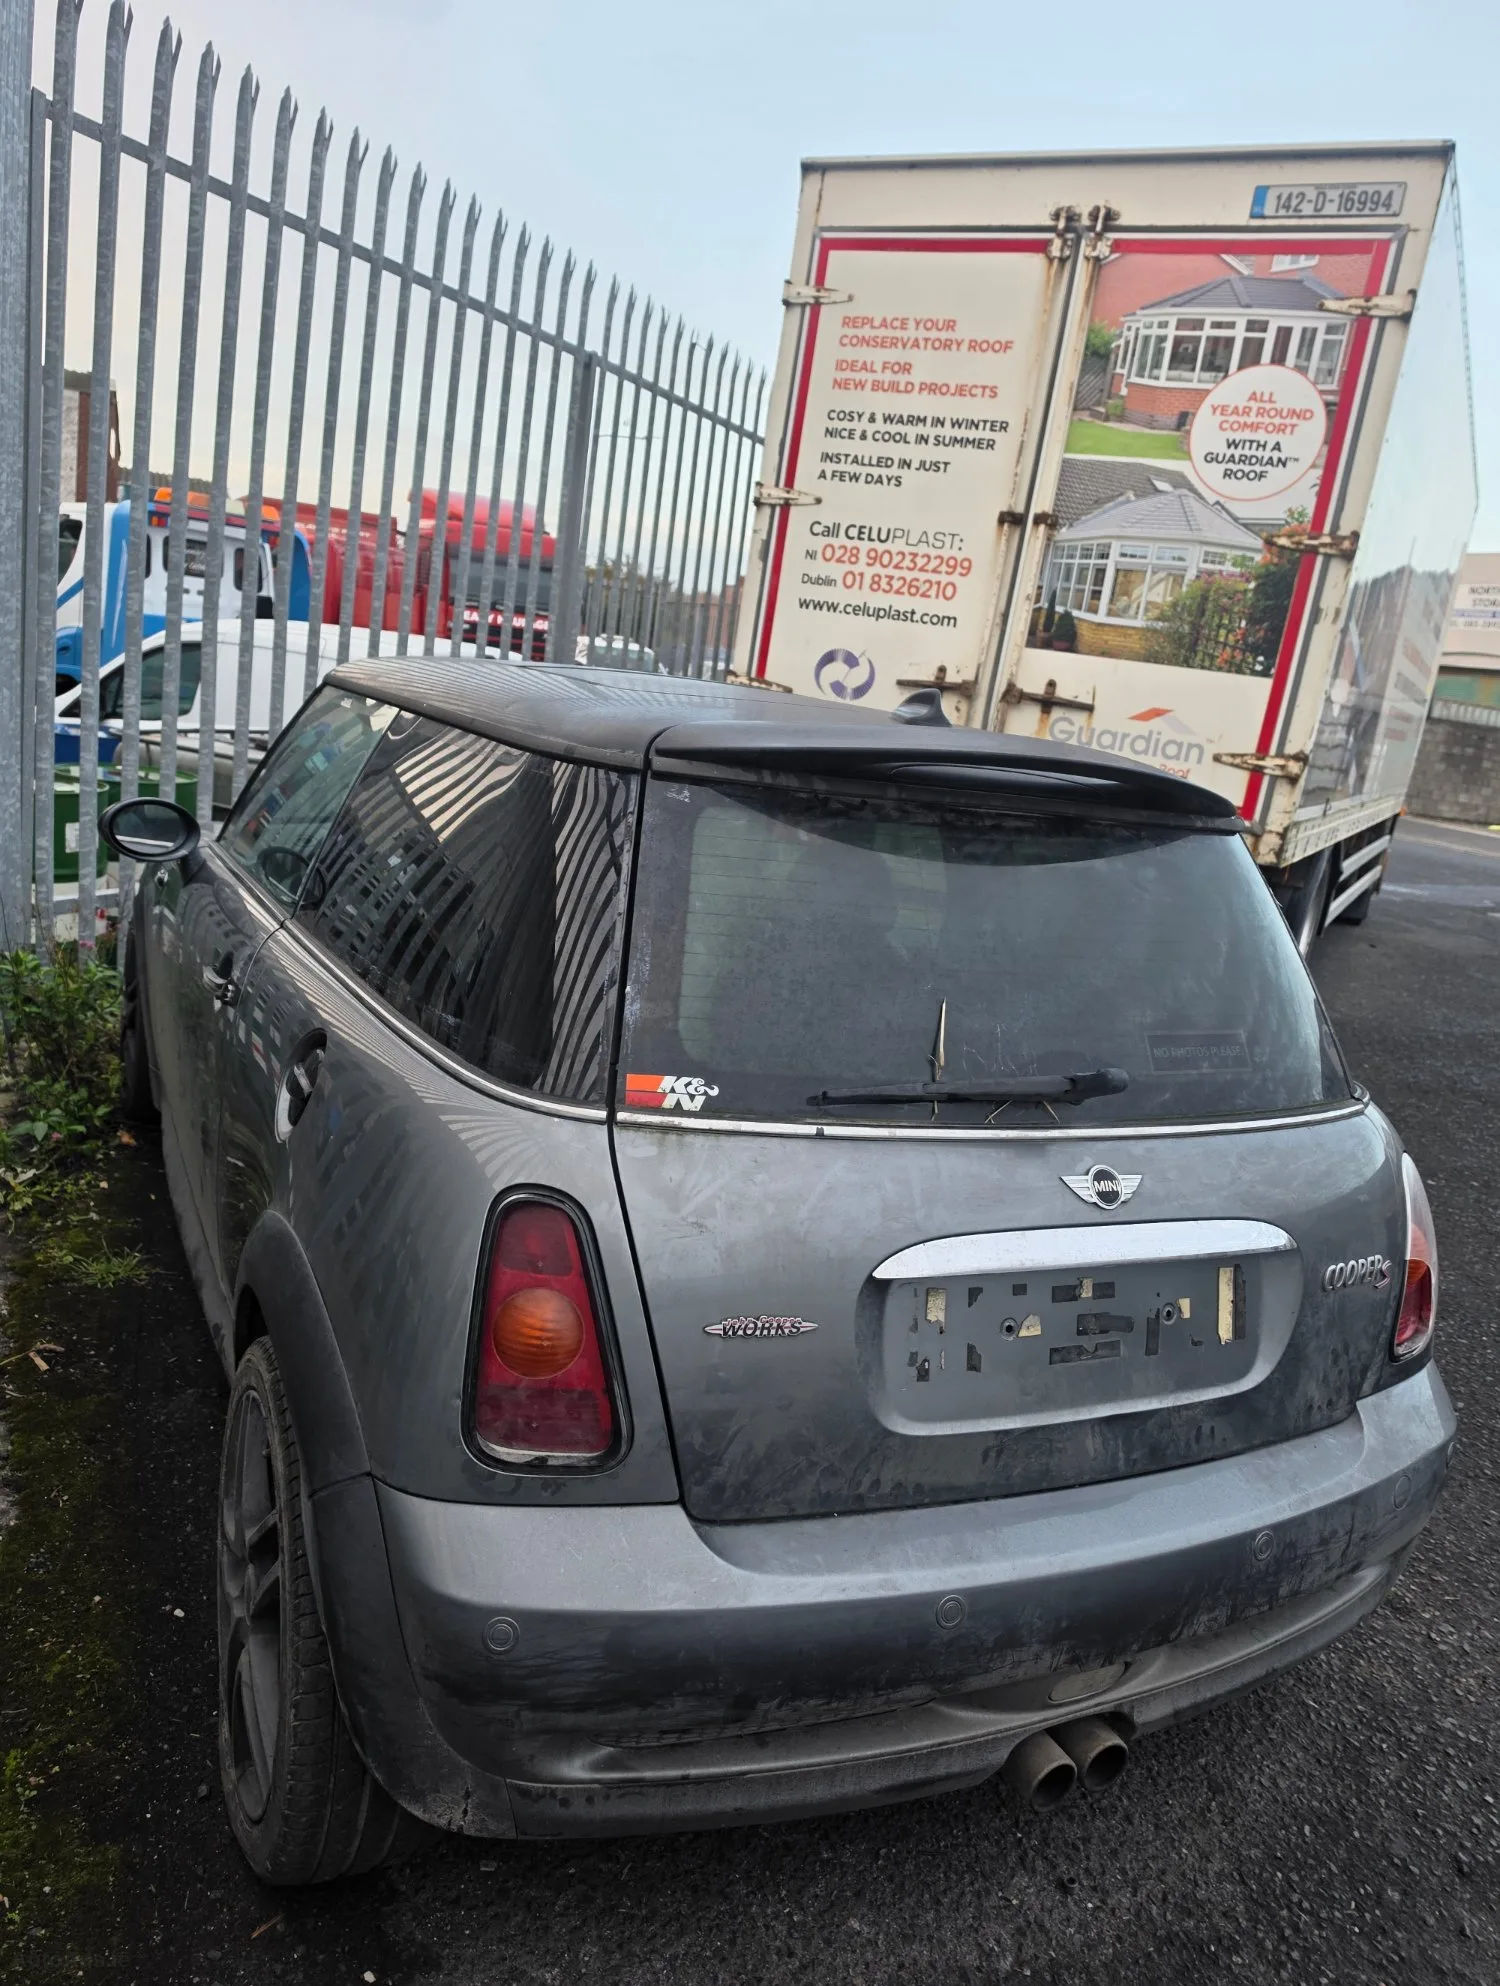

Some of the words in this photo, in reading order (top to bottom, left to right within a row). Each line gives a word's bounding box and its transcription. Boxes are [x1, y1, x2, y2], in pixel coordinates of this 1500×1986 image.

[1274, 189, 1395, 214] 142-D-16994
[841, 316, 910, 331] REPLACE
[913, 318, 957, 333] YOUR
[839, 334, 964, 352] CONSERVATORY
[967, 340, 1014, 354] ROOF
[835, 359, 877, 374] IDEAL
[880, 361, 913, 375] FOR
[832, 378, 868, 392] NEW
[870, 380, 914, 394] BUILD
[918, 382, 999, 399] PROJECTS
[1247, 391, 1277, 404] ALL
[827, 409, 865, 423] COSY
[868, 412, 877, 424] &
[882, 413, 927, 429] WARM
[930, 416, 945, 430] IN
[949, 417, 1009, 433] WINTER
[1210, 404, 1252, 418] YEAR
[1255, 407, 1314, 421] ROUND
[1219, 420, 1299, 436] COMFORT
[824, 427, 856, 441] NICE
[859, 429, 868, 442] &
[872, 430, 910, 445] COOL
[914, 433, 929, 446] IN
[933, 435, 996, 451] SUMMER
[1225, 438, 1267, 452] WITH
[1270, 440, 1282, 453] A
[820, 452, 894, 469] INSTALLED
[897, 458, 912, 470] IN
[914, 459, 951, 473] JUST
[817, 469, 828, 481] A
[830, 470, 862, 484] FEW
[864, 473, 902, 487] DAYS
[1222, 468, 1268, 482] ROOF
[809, 520, 840, 539] Call
[844, 523, 964, 551] CELUPLAST:
[804, 549, 817, 561] NI
[821, 543, 860, 565] 028
[865, 547, 972, 577] 90232299
[801, 573, 837, 588] Dublin
[842, 570, 864, 590] 01
[869, 573, 957, 601] 8326210
[798, 597, 958, 628] www.celuplast.com
[1049, 715, 1205, 765] Guardian
[1093, 1180, 1121, 1192] MINI
[722, 1321, 803, 1337] WORKS
